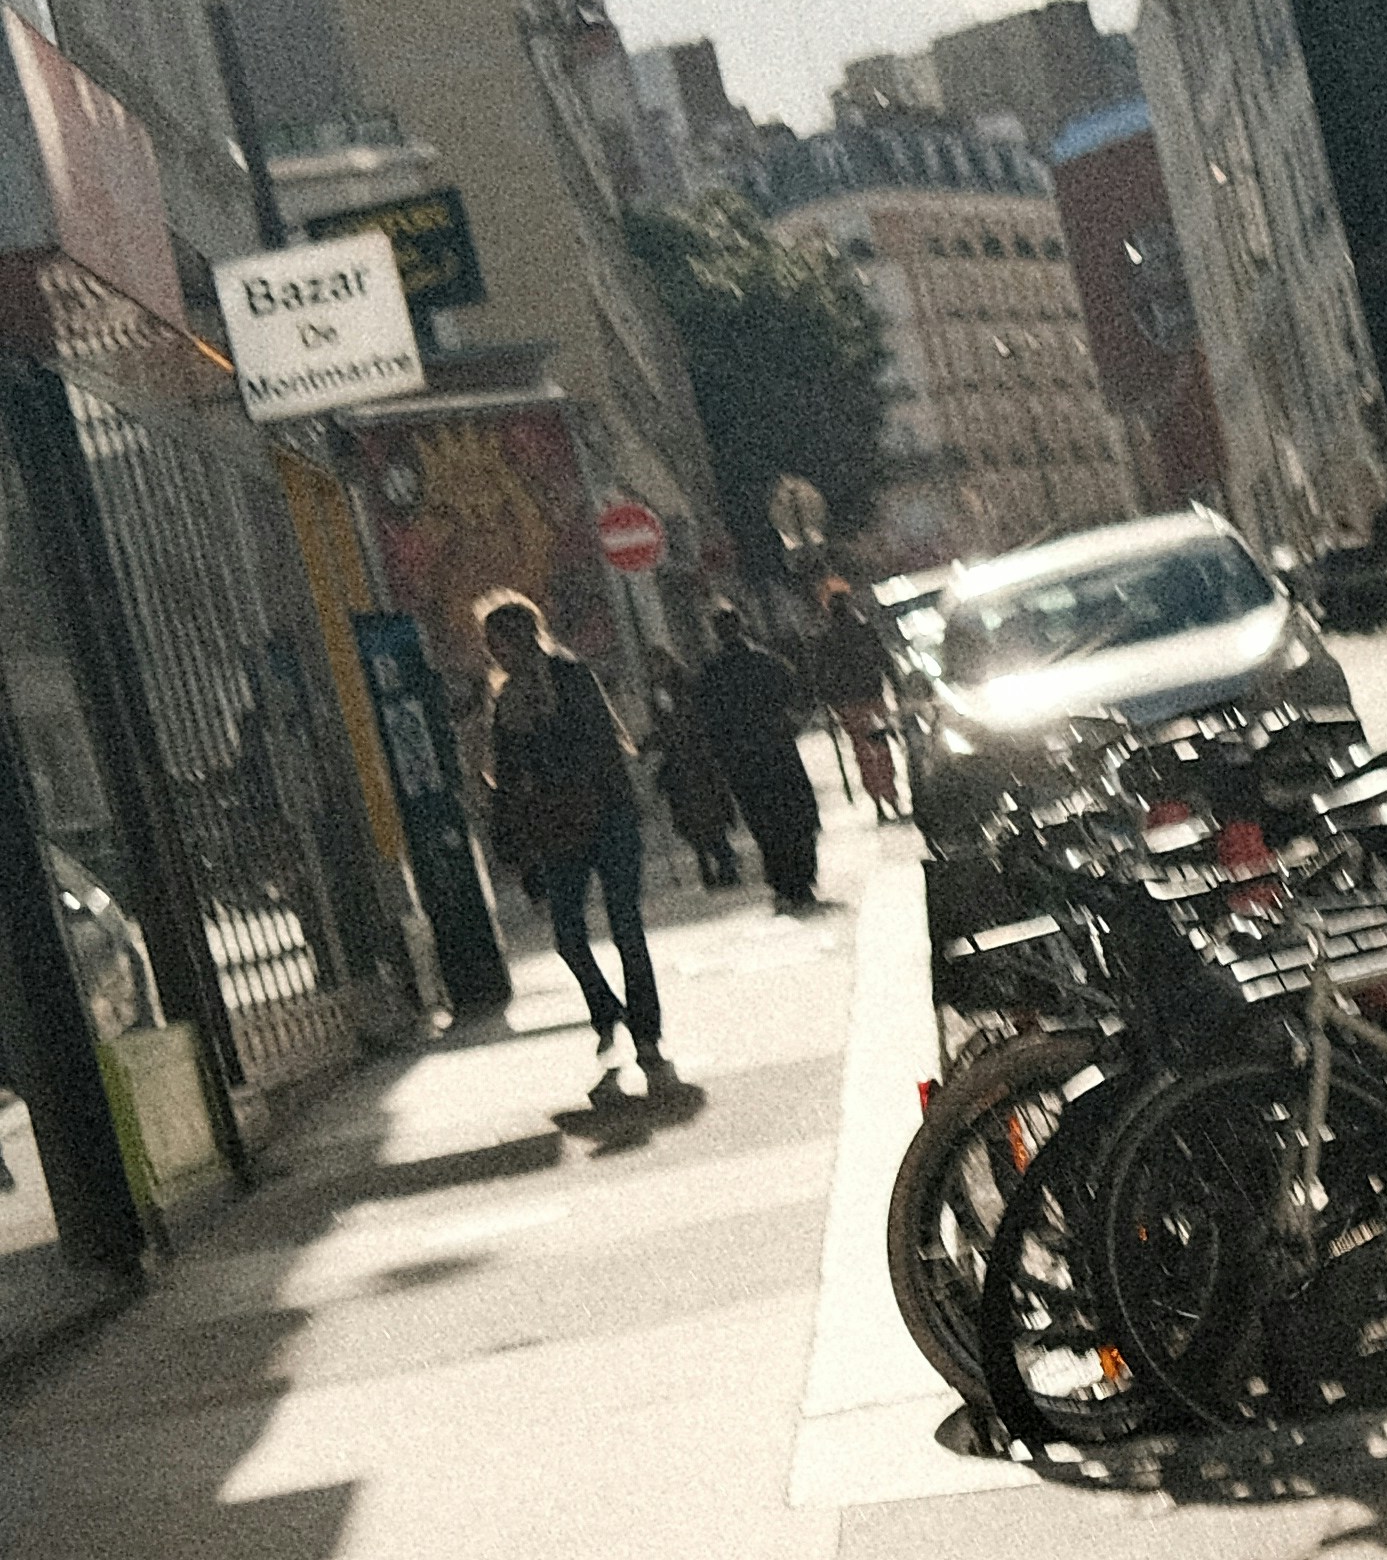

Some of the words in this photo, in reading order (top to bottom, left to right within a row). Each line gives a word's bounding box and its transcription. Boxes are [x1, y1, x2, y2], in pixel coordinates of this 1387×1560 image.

[241, 263, 370, 318] Bazar
[297, 321, 339, 349] De
[245, 351, 415, 402] Montmartre
